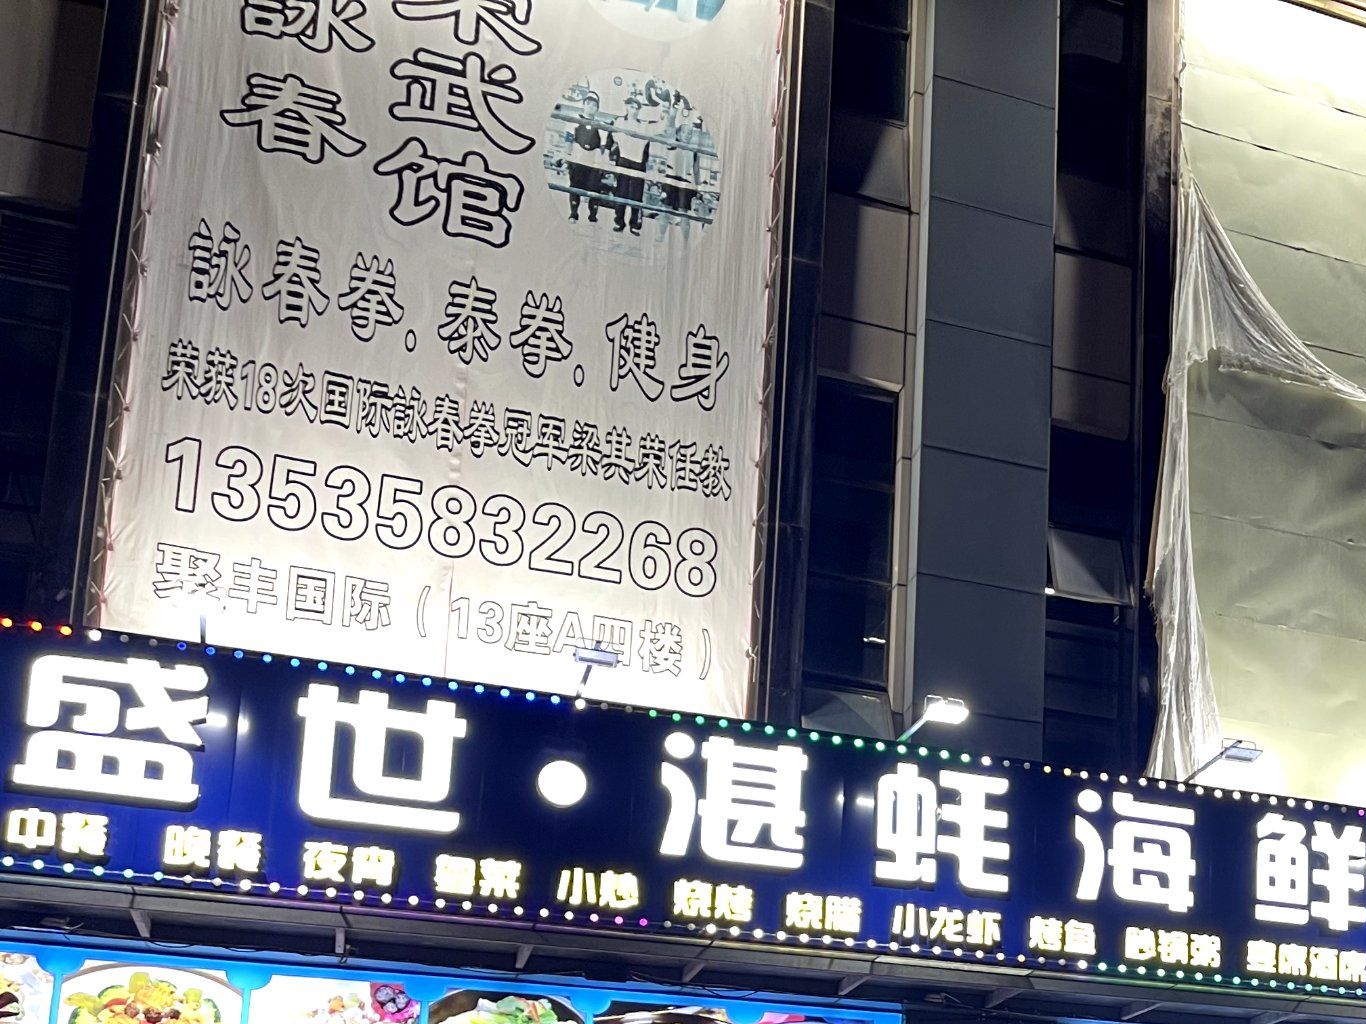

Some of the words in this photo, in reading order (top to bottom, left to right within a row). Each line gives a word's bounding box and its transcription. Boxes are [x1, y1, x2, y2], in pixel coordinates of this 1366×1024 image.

[164, 437, 718, 598] 13535832268
[892, 902, 1002, 947] 小龙虾
